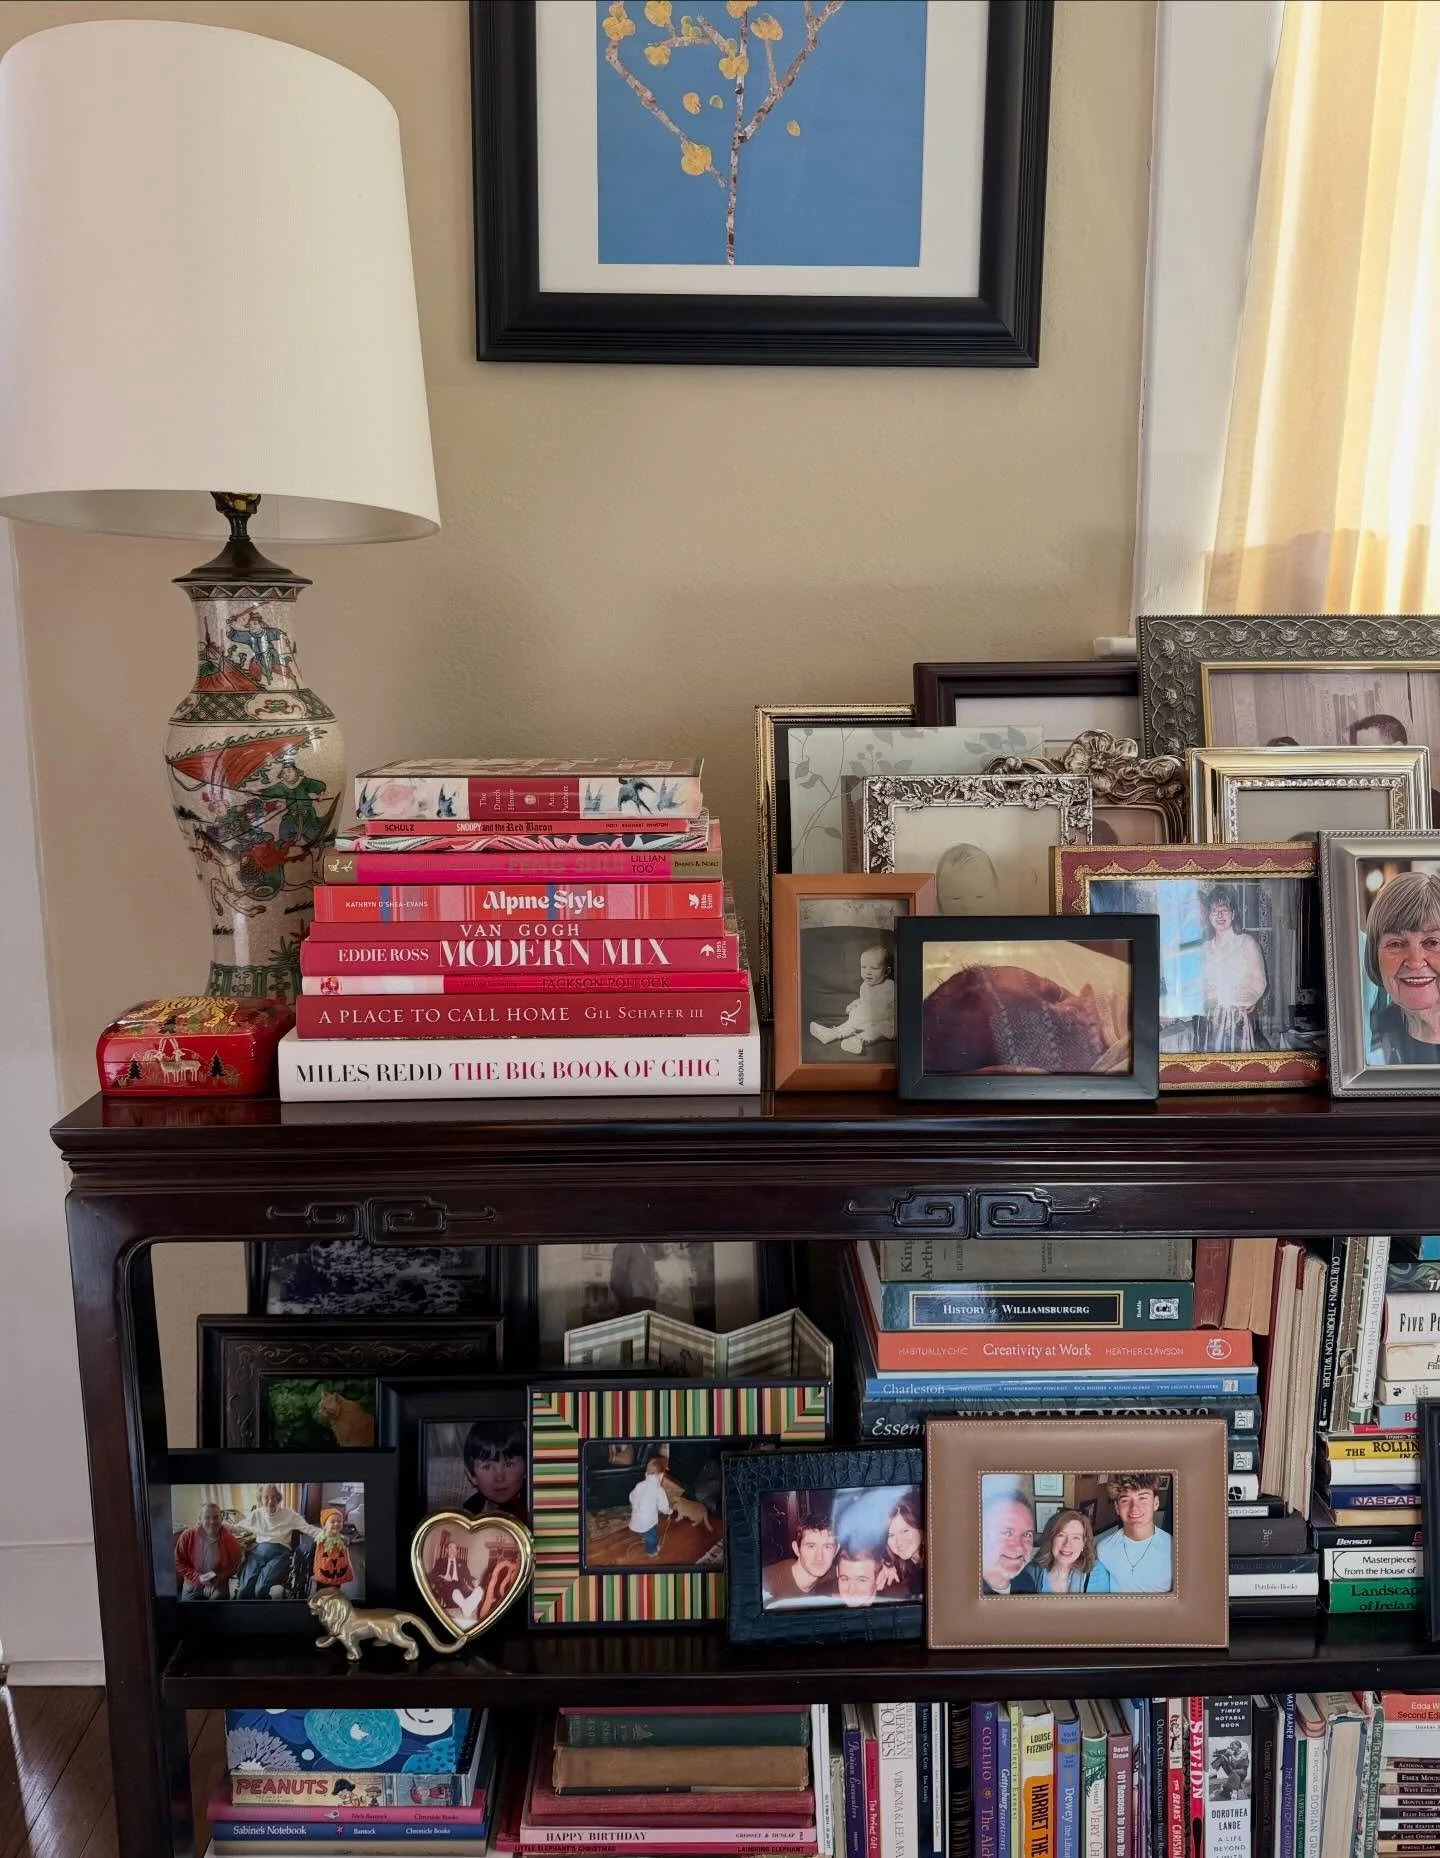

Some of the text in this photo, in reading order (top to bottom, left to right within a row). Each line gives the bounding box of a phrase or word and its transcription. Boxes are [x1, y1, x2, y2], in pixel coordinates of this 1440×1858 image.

[479, 791, 487, 808] The
[493, 788, 502, 811] Dutch
[507, 788, 516, 811] House
[547, 791, 556, 808] Ann
[561, 785, 570, 814] Patchett
[384, 823, 415, 833] SCHULZ
[456, 821, 553, 833] SNOOPY and the Red Baron
[630, 854, 667, 863] LILLIAN
[631, 864, 654, 873] TOO
[345, 900, 429, 909] KATHRYN O'SHEA-EVANS
[483, 890, 605, 912] Alpine Style
[460, 923, 580, 937] VAN GOGH
[338, 947, 429, 962] EDDIE ROSS
[439, 938, 672, 967] MODERN MIX
[542, 976, 670, 990] JACKSON POLLOCK
[318, 1007, 570, 1024] A PLACE TO CALL HOME
[585, 1005, 704, 1020] GIL SCHAFER III
[296, 1063, 442, 1083] MILES REDD
[449, 1058, 721, 1081] THE BIG BOOK OF CHIC
[737, 1047, 745, 1087] ASSOULINE
[1328, 1256, 1341, 1302] OUR TOWN
[1366, 1240, 1386, 1348] HUCKLEBERRY FINN
[943, 1304, 985, 1315] HISTORY
[1399, 1313, 1424, 1333] FIVE
[1325, 1307, 1337, 1358] THORNTON
[982, 1343, 1092, 1360] Creativity at Work
[1105, 1346, 1184, 1357] HEATHER CLAWSON
[1322, 1358, 1333, 1389] WILDER
[883, 1382, 945, 1396] Charleston
[1236, 1412, 1245, 1428] DP
[1235, 1452, 1244, 1468] DP
[1345, 1448, 1366, 1457] THE
[1353, 1496, 1417, 1505] NASCAR
[1336, 1537, 1372, 1546] Benson
[1362, 1556, 1417, 1565] Masterpieces
[1344, 1566, 1417, 1576] from the House of
[1351, 1584, 1423, 1598] Landscap
[1359, 1600, 1374, 1611] of
[1397, 1711, 1427, 1720] Second
[1156, 1719, 1165, 1744] OCEAN
[1286, 1713, 1295, 1739] MAHER
[1030, 1731, 1051, 1744] LOUISE
[981, 1726, 992, 1781] COELHO
[235, 1778, 329, 1796] PEANUTS
[894, 1770, 904, 1813] VIRGINIA
[998, 1768, 1010, 1810] Gettysburg
[1364, 1721, 1383, 1851] THE TALE OF SQUIRREL NUTKIN
[1283, 1767, 1293, 1823] THE ADVENT OF
[869, 1799, 877, 1812] The
[1063, 1787, 1075, 1836] Dewey the
[1117, 1770, 1126, 1843] 101 Reasons Love
[1172, 1791, 1182, 1821] BEARS'
[1211, 1808, 1248, 1819] DOROTHEA
[1309, 1794, 1319, 1833] DORIAN
[869, 1813, 877, 1835] Perfect
[894, 1813, 904, 1821] &
[981, 1806, 995, 1832] The
[1031, 1783, 1050, 1858] HARRIET THE
[1218, 1820, 1241, 1830] LANGE
[233, 1825, 307, 1836] Sabine's Notebook
[353, 1827, 376, 1835] Bantock
[406, 1827, 433, 1835] Chronicle
[546, 1831, 647, 1841] HAPPY BIRTHDAY
[894, 1821, 904, 1838] LEE
[514, 1844, 535, 1852] LITTLE
[577, 1844, 616, 1852] CHRISTMAS
[737, 1845, 805, 1853] LAUGHING ELEPHANT
[1309, 1835, 1318, 1858] GRAY
